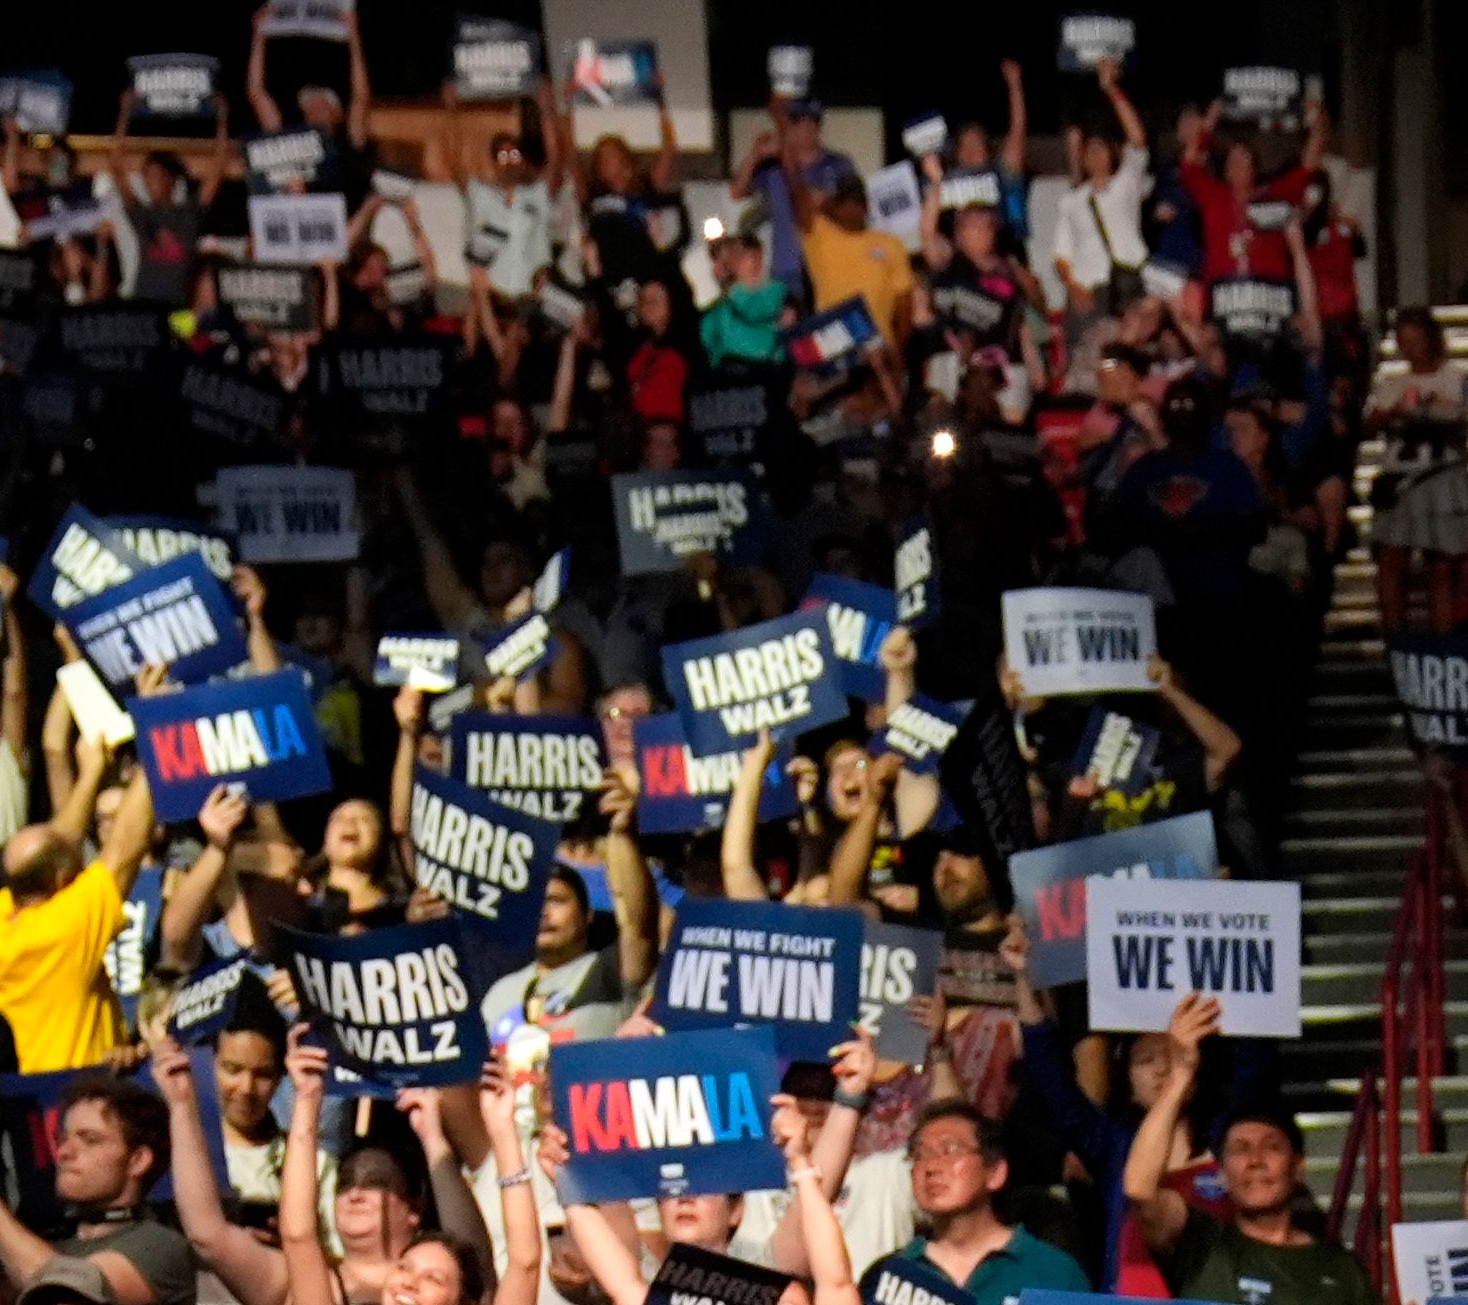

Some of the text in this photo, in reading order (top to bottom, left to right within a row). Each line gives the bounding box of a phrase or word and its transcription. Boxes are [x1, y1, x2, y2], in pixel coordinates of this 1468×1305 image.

[682, 628, 825, 712] HARRIS
[1022, 627, 1140, 666] WE WIN
[719, 684, 812, 737] WALZ
[150, 702, 309, 782] KAMALA
[466, 729, 604, 791] HARRIS
[411, 783, 535, 893] HARRIS
[681, 927, 837, 959] WHEN WE FIGHT
[1116, 910, 1270, 932] WHEN WE VOTE
[295, 941, 469, 1028] HARRIS
[667, 956, 835, 1024] WE WIN
[1112, 935, 1275, 995] WE WIN
[334, 1020, 461, 1065] WALZ
[568, 1071, 764, 1155] KAMALA
